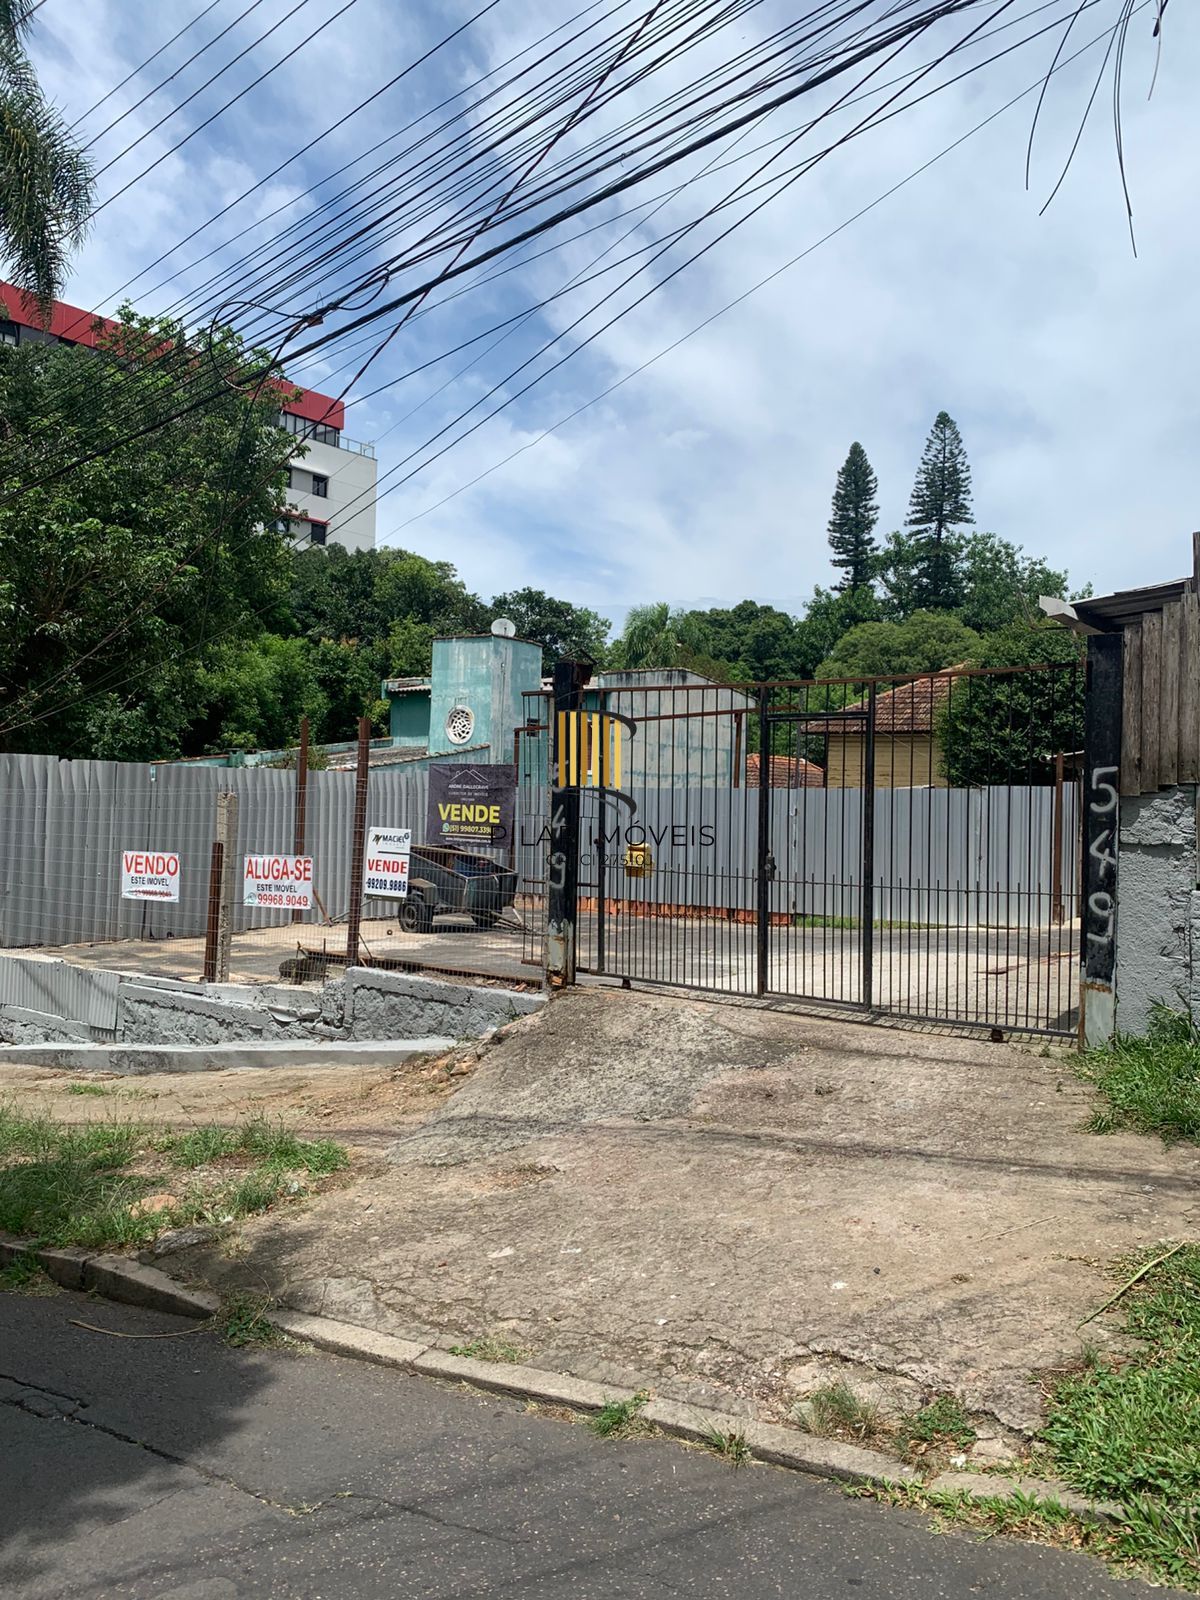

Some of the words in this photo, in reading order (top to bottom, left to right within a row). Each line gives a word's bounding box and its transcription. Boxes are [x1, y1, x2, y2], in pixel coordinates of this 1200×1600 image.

[438, 803, 500, 824] VENDE
[124, 854, 178, 876] VENDO
[245, 858, 312, 881] ALUGA-SE
[368, 858, 408, 874] VENDE
[131, 876, 146, 885] ESTE
[256, 883, 273, 892] ESTE
